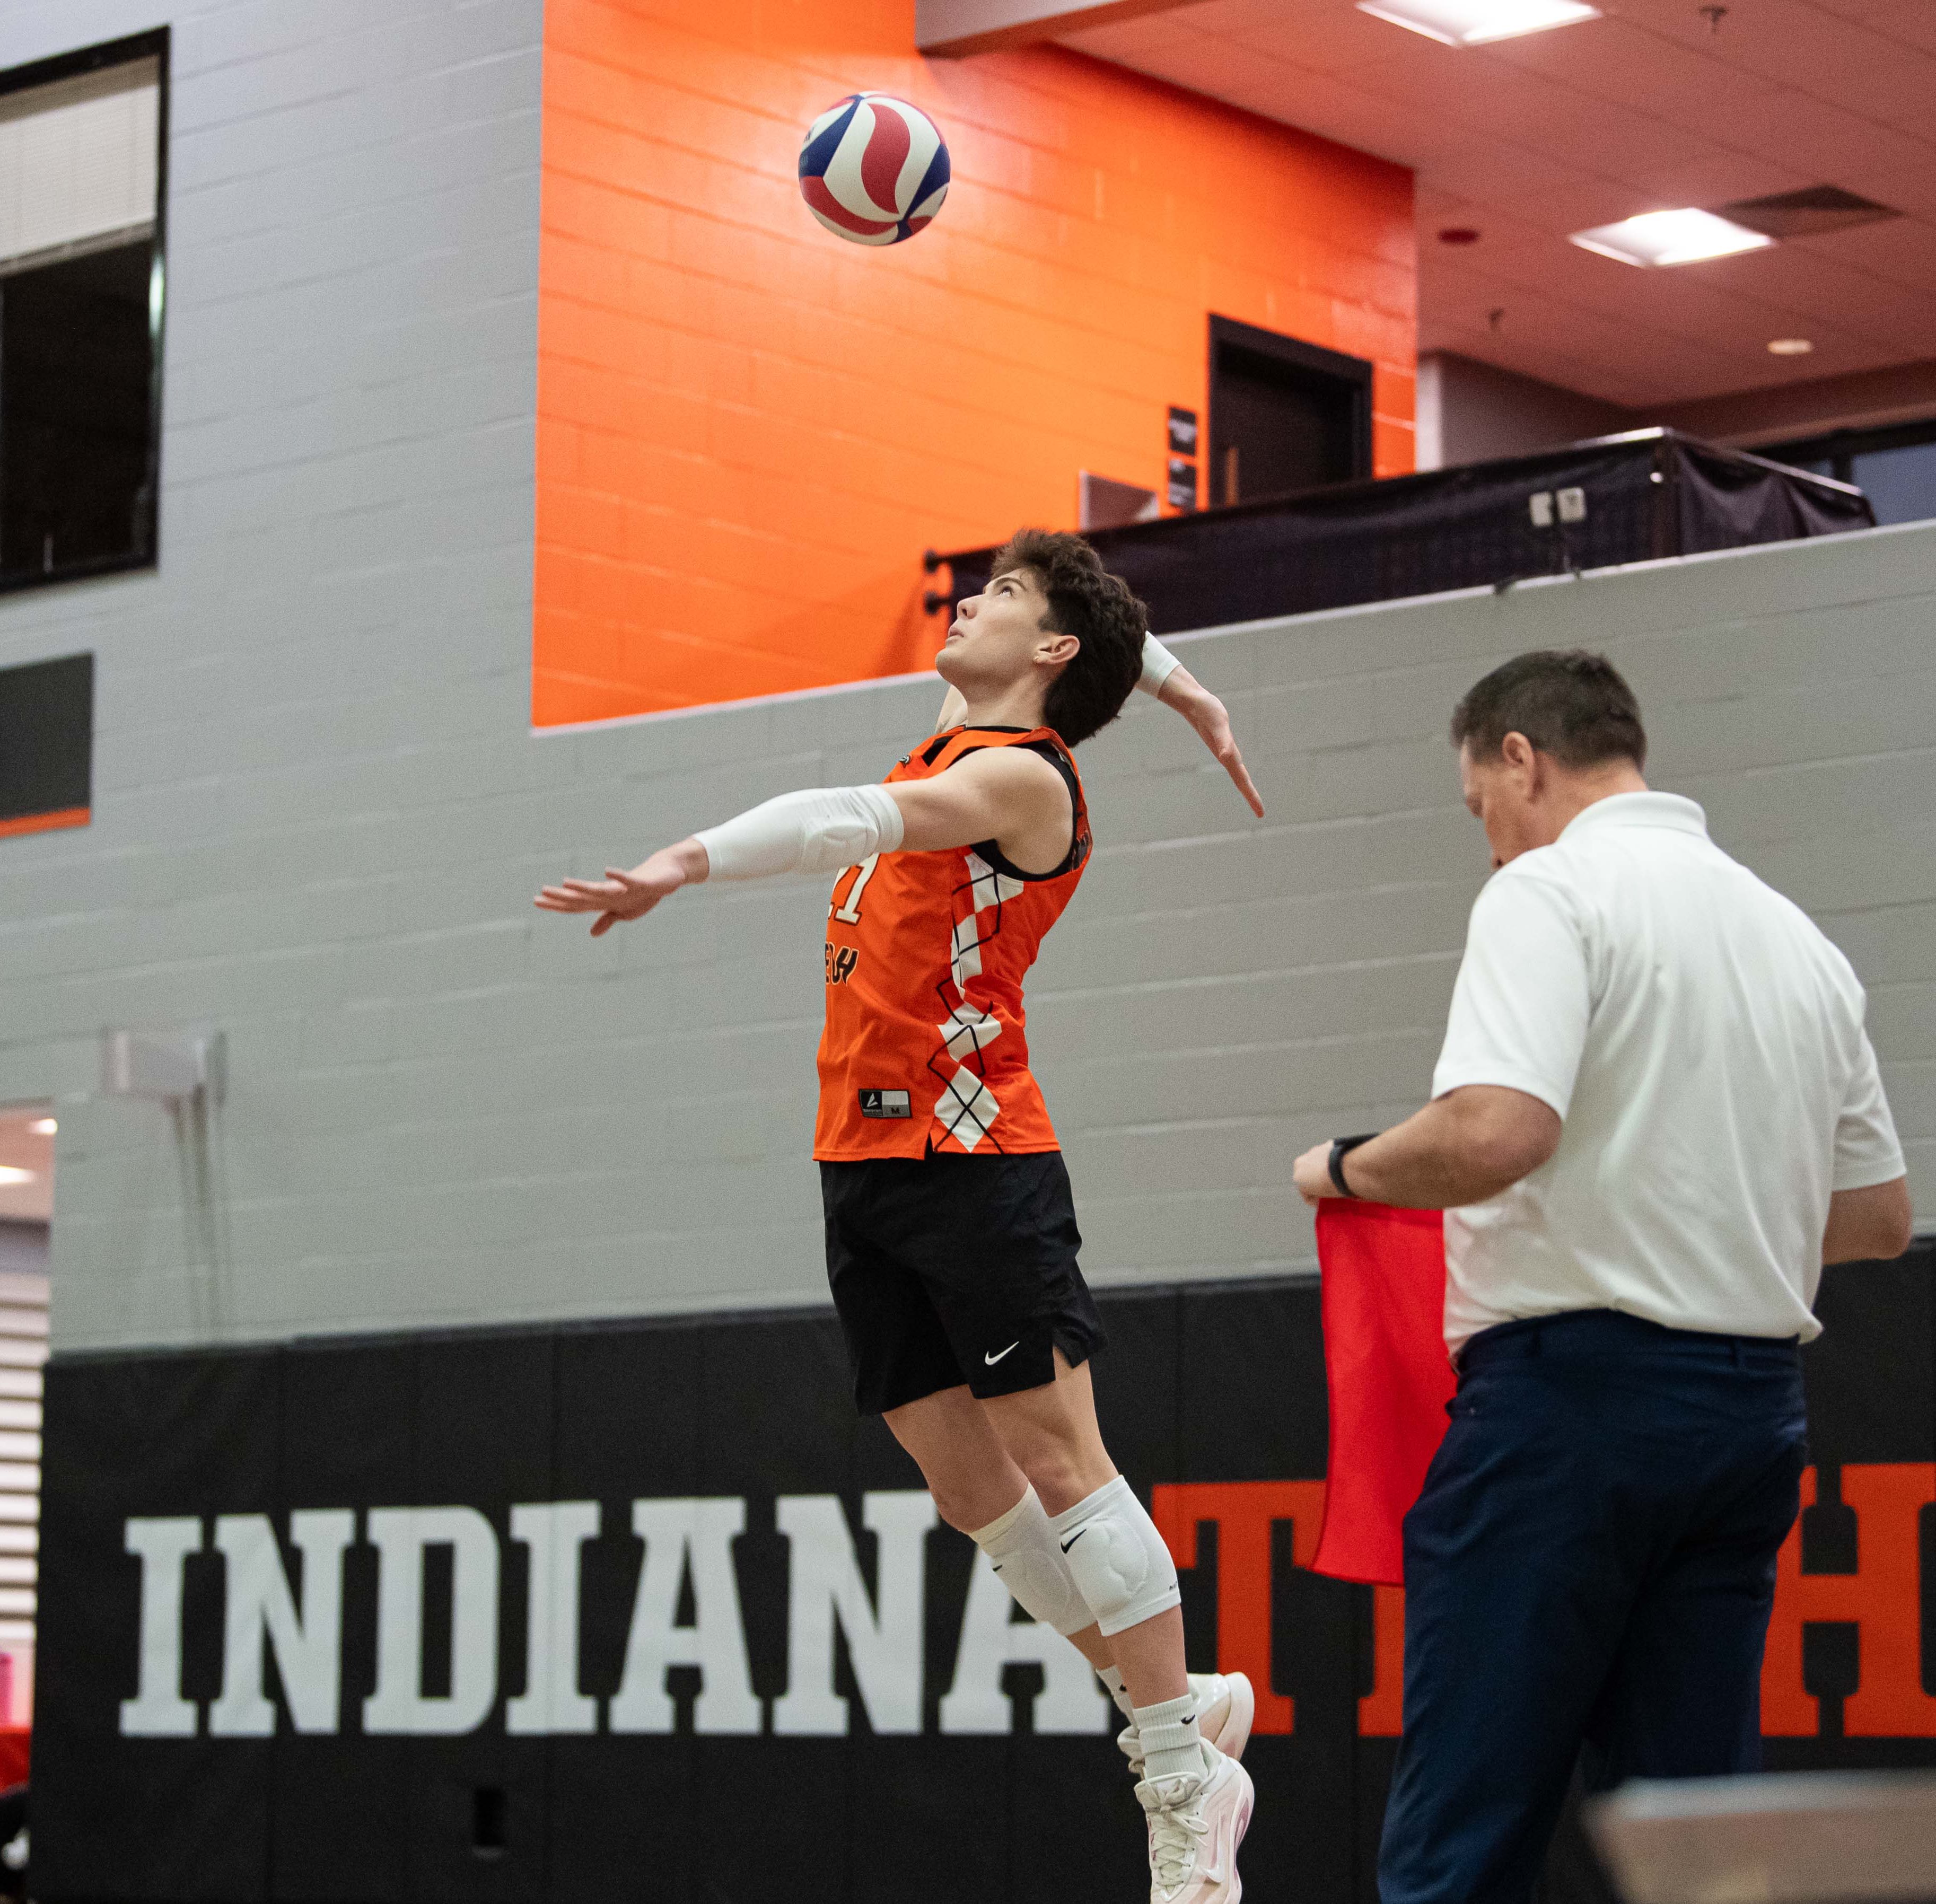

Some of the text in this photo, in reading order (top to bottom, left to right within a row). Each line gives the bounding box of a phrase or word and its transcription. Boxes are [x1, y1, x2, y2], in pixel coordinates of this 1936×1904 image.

[828, 851, 881, 926] 1
[119, 1462, 1936, 1738] INDIANA TH
